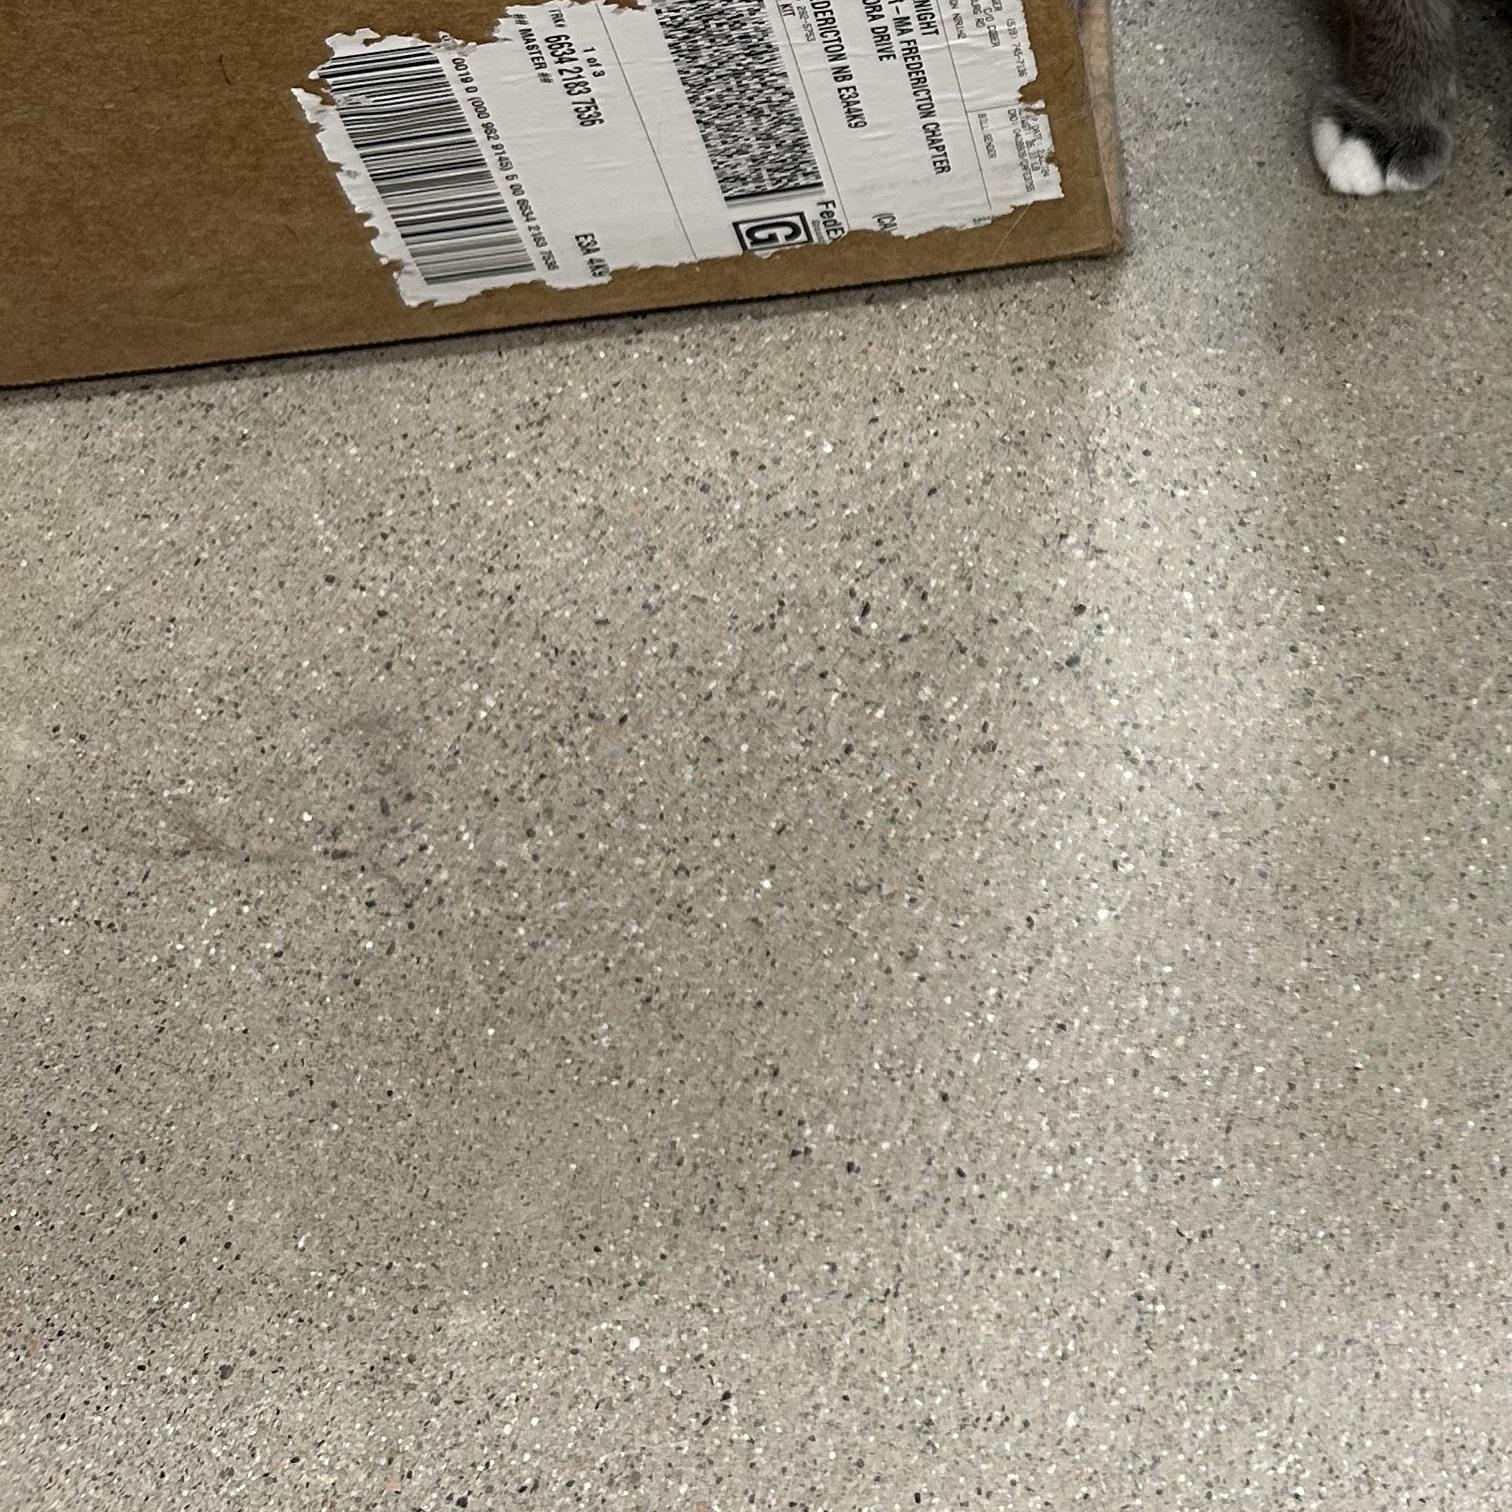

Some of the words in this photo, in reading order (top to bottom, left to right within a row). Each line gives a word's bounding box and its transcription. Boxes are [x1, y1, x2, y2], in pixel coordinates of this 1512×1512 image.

[779, 2, 796, 17] KIT
[517, 27, 548, 70] MASTER
[543, 33, 579, 65] 6634
[581, 45, 596, 53] 1
[869, 24, 897, 62] DRIVE
[585, 56, 603, 68] of
[591, 69, 606, 78] 3
[830, 64, 853, 83] NB
[450, 56, 474, 84] 0019
[466, 95, 490, 120] (000
[556, 65, 592, 96] 2183
[570, 96, 604, 127] 7536
[836, 84, 867, 129] E3A4K9
[899, 38, 936, 119] FREDERICTON
[921, 121, 951, 175] CHAPTER
[744, 219, 802, 249] G
